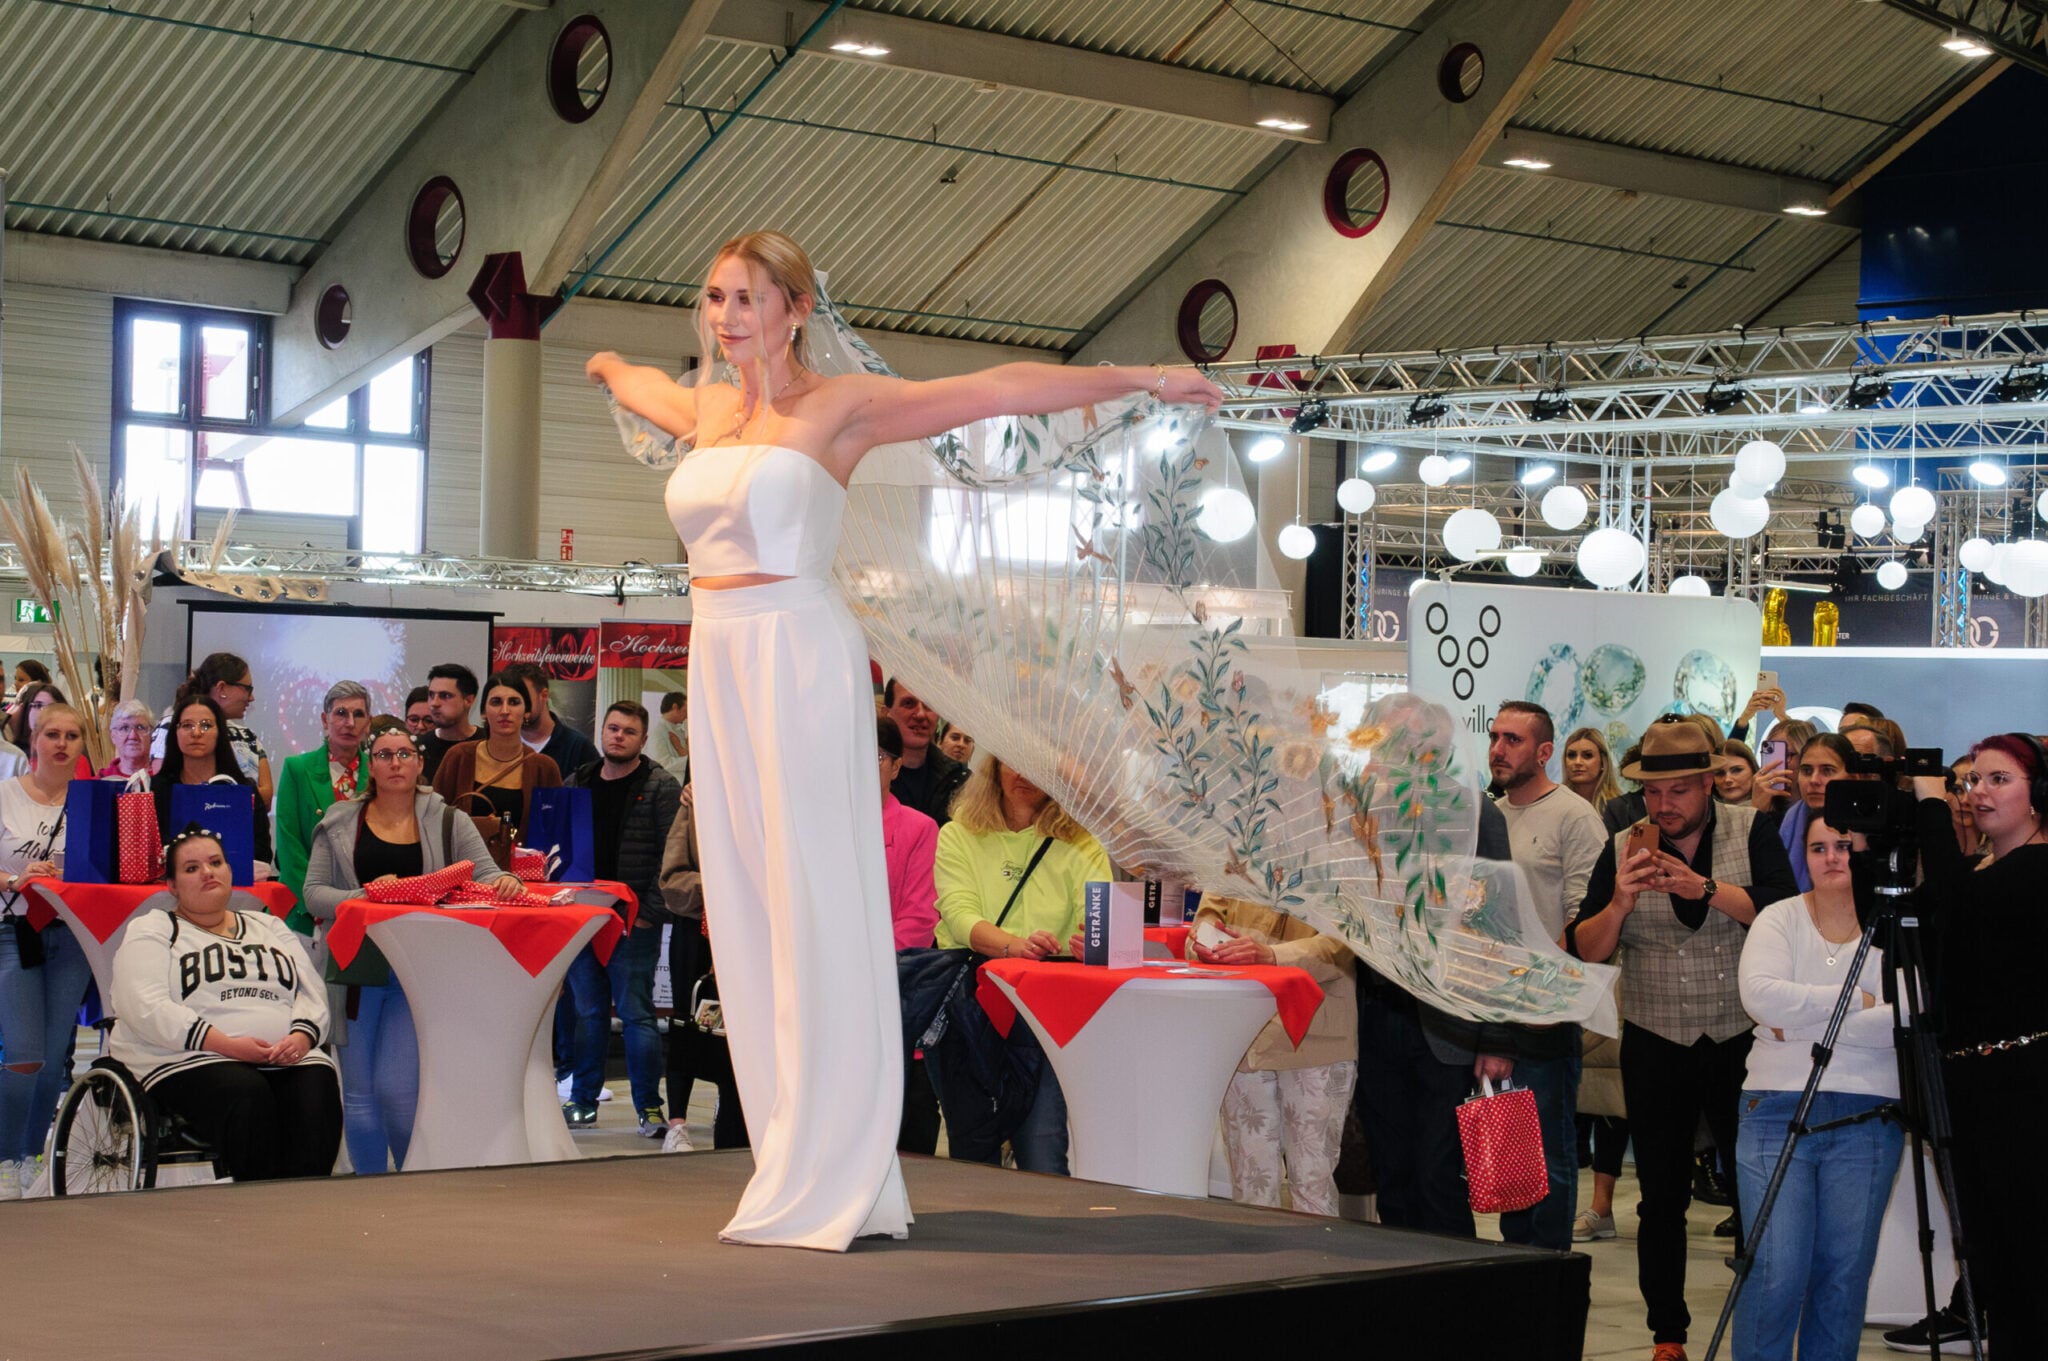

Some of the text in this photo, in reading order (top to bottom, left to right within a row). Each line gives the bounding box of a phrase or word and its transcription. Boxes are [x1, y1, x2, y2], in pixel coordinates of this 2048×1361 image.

[1862, 593, 1929, 602] FACHGESCHÄFT
[493, 641, 596, 668] Hochzeitsfeuerwerke
[609, 635, 689, 654] Hochzei
[1088, 887, 1102, 948] GETRÄNKE
[180, 942, 300, 1001] BOSTO
[220, 987, 280, 1002] BEYOND SEL
